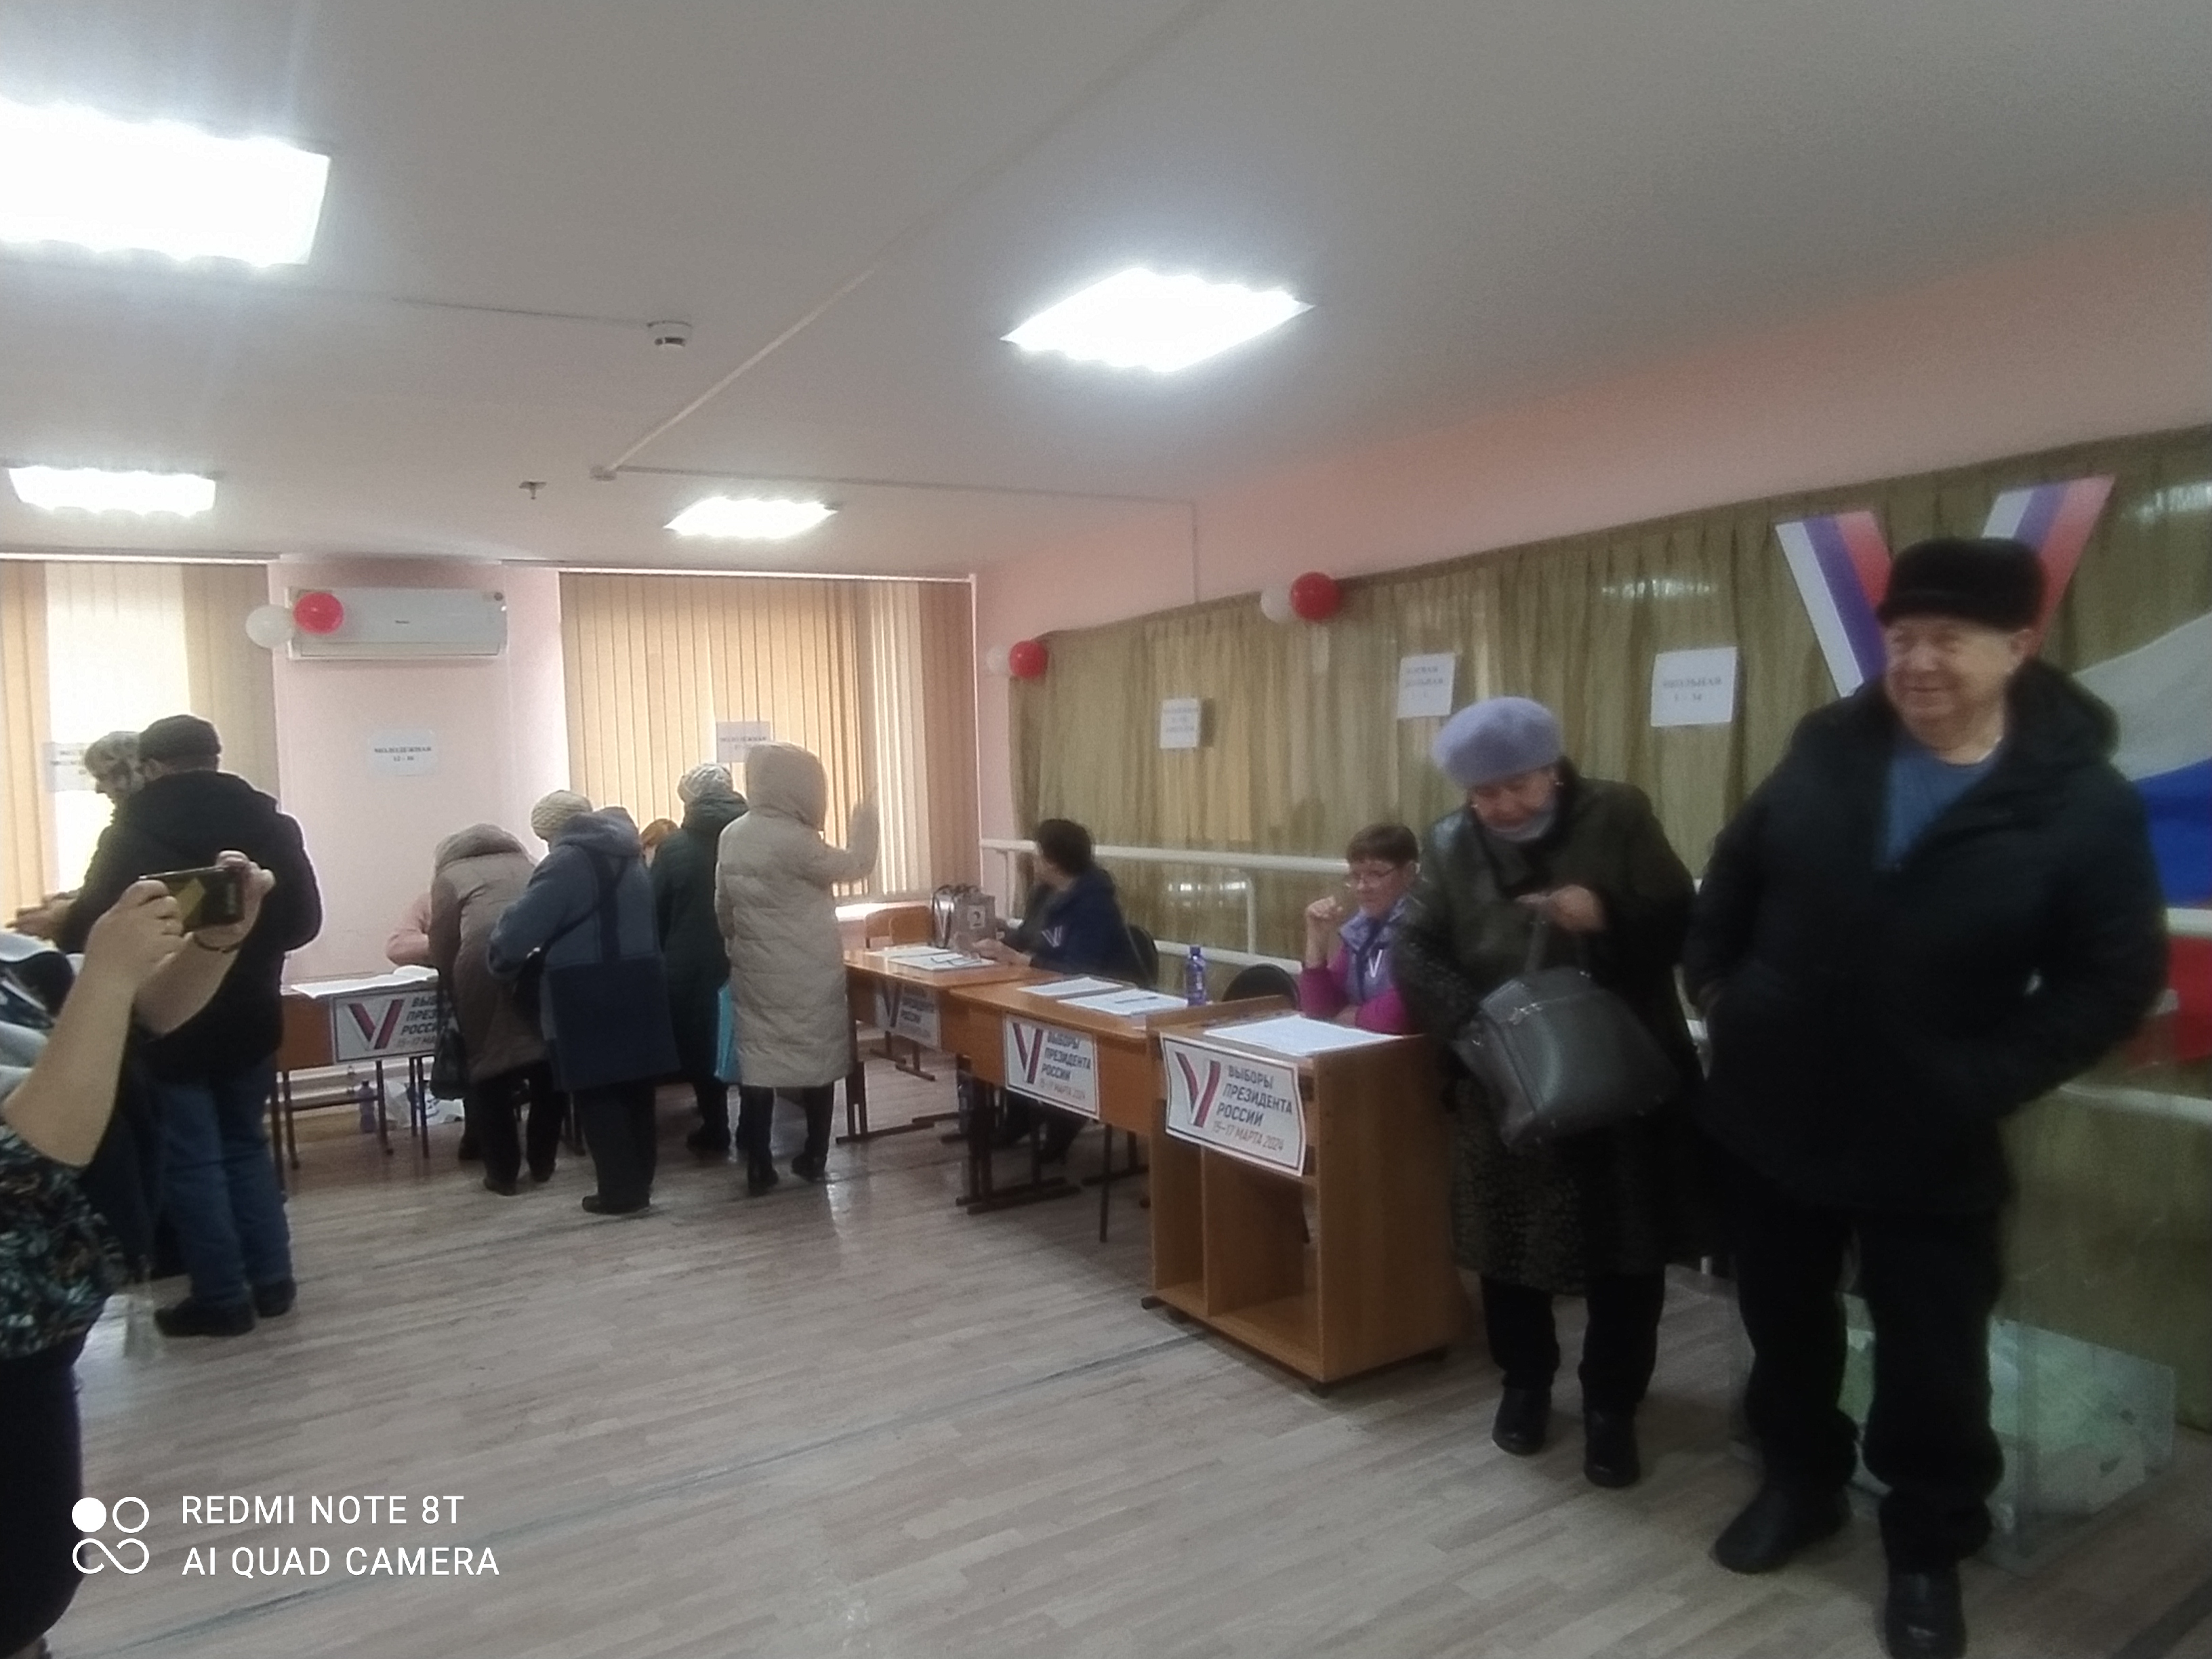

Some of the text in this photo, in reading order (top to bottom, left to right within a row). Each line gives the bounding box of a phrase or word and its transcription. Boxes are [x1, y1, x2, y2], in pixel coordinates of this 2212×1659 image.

[1228, 1065, 1273, 1088] ВЫБОРЫ
[1222, 1084, 1293, 1114] ПРЕЗИДЕНТА
[1216, 1103, 1265, 1127] РОССИИ
[1235, 1128, 1263, 1145] МАРТА
